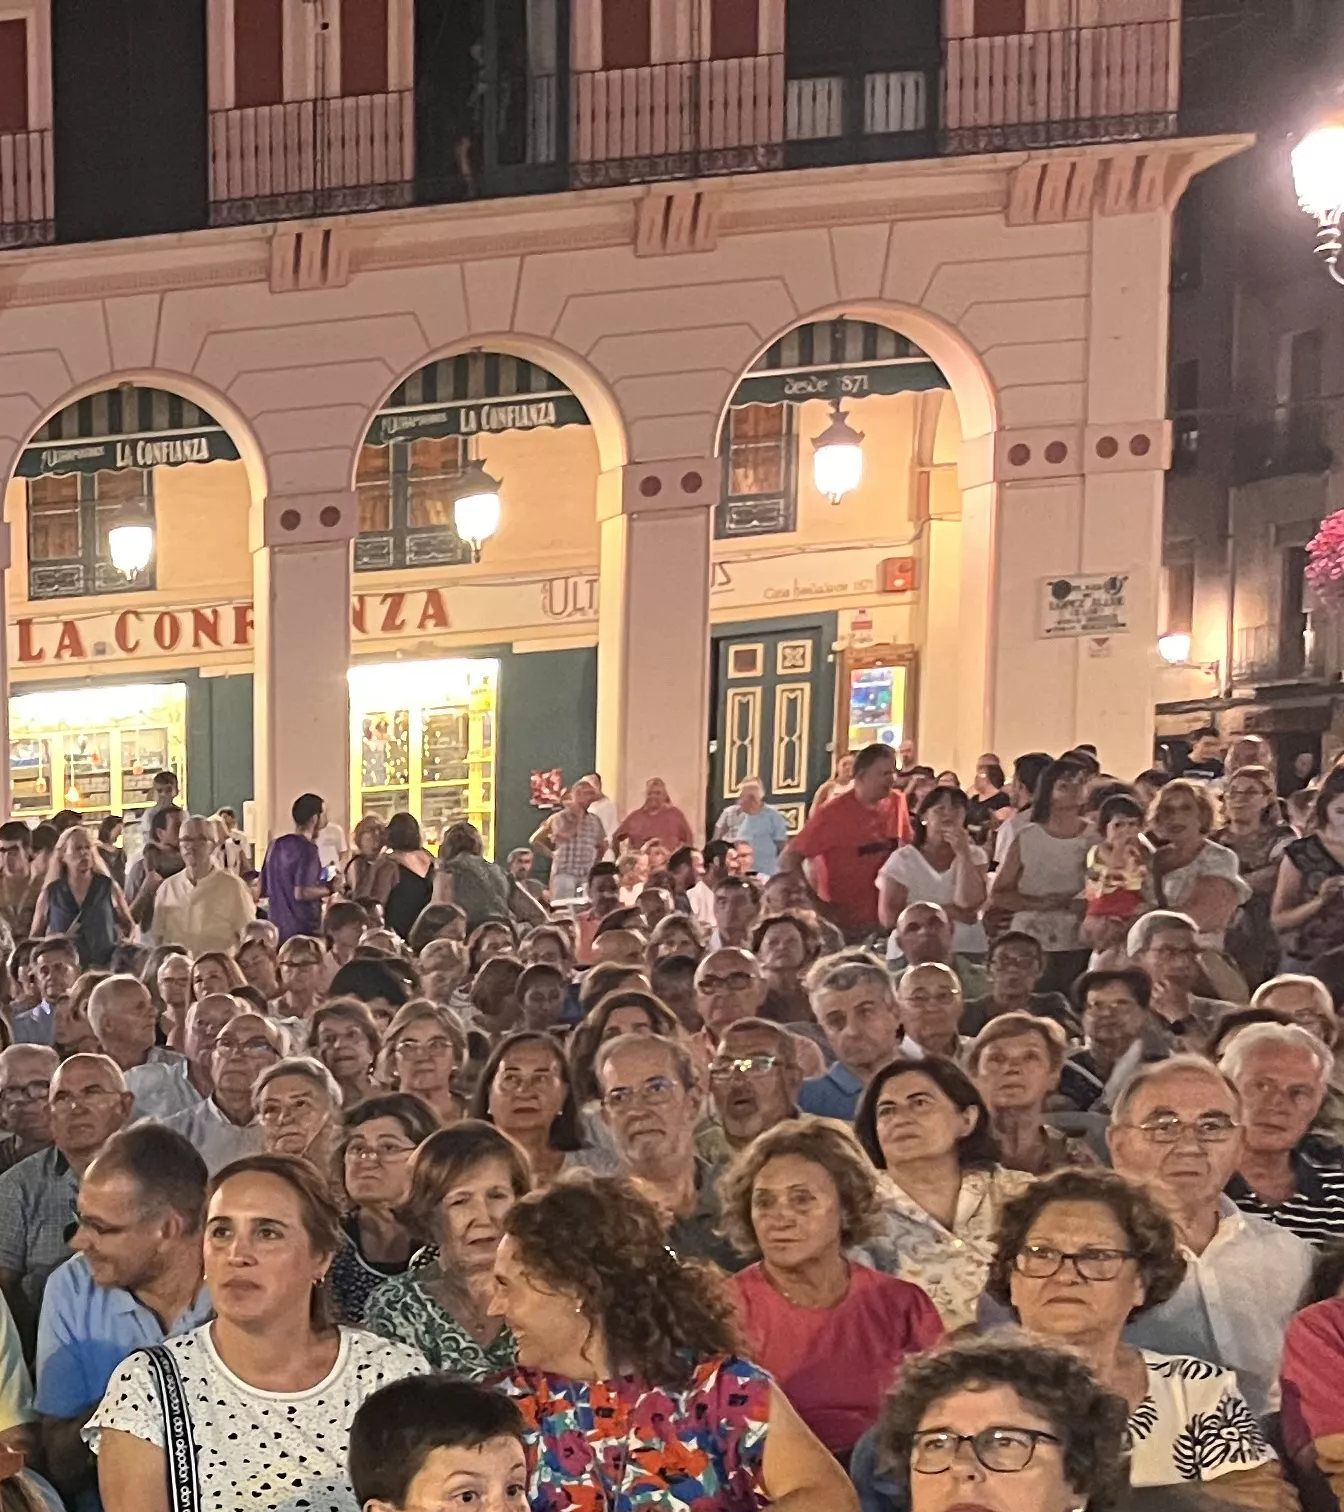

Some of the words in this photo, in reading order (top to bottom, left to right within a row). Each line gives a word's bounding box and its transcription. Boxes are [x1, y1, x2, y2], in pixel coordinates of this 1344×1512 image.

[460, 407, 477, 433] LA
[480, 402, 557, 430] CONFIANZA
[116, 442, 133, 468] LA
[136, 437, 210, 466] CONFIANZA
[16, 617, 87, 662] LA
